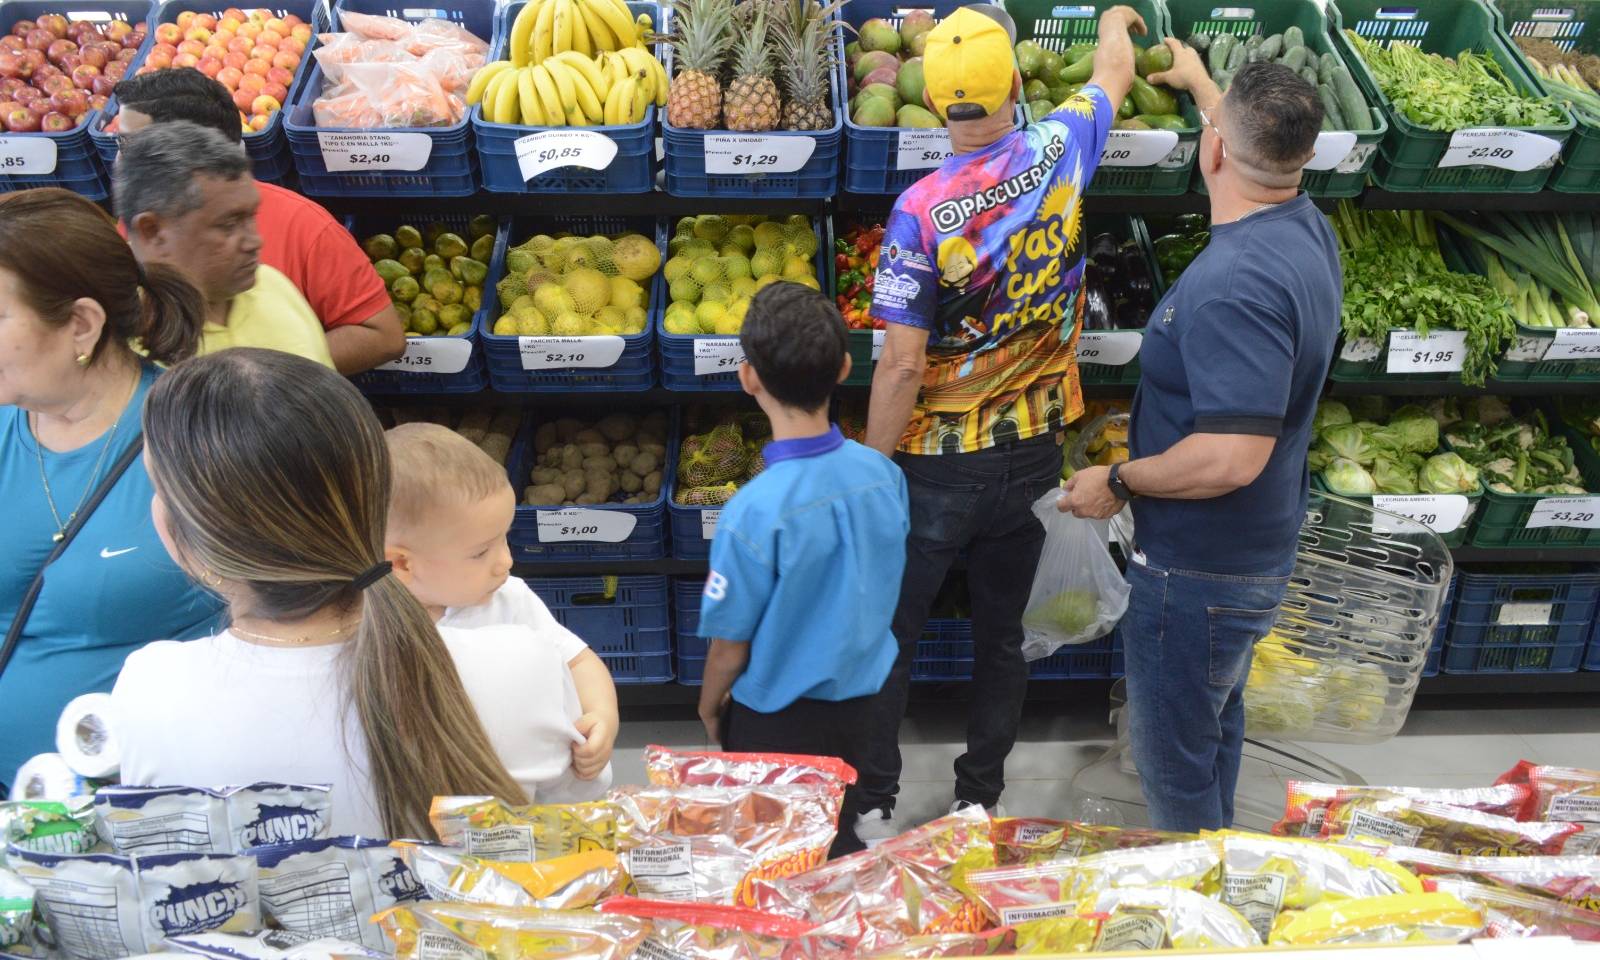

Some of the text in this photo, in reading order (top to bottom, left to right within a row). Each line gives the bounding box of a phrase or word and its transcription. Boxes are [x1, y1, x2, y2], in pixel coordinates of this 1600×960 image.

[349, 153, 391, 164] $2,40
[538, 147, 583, 163] $0,85
[1467, 147, 1514, 159] $2,80
[732, 154, 778, 166] $1,29
[545, 353, 585, 362] $2,10
[1412, 351, 1453, 363] $1,95
[1551, 511, 1594, 522] $3,20
[560, 526, 598, 535] $1,00
[632, 846, 684, 856] INFORMACIÓN
[632, 853, 681, 863] NUTRICIONAL
[148, 882, 247, 929] PUNCH
[1008, 908, 1067, 921] INFORMACIÓN
